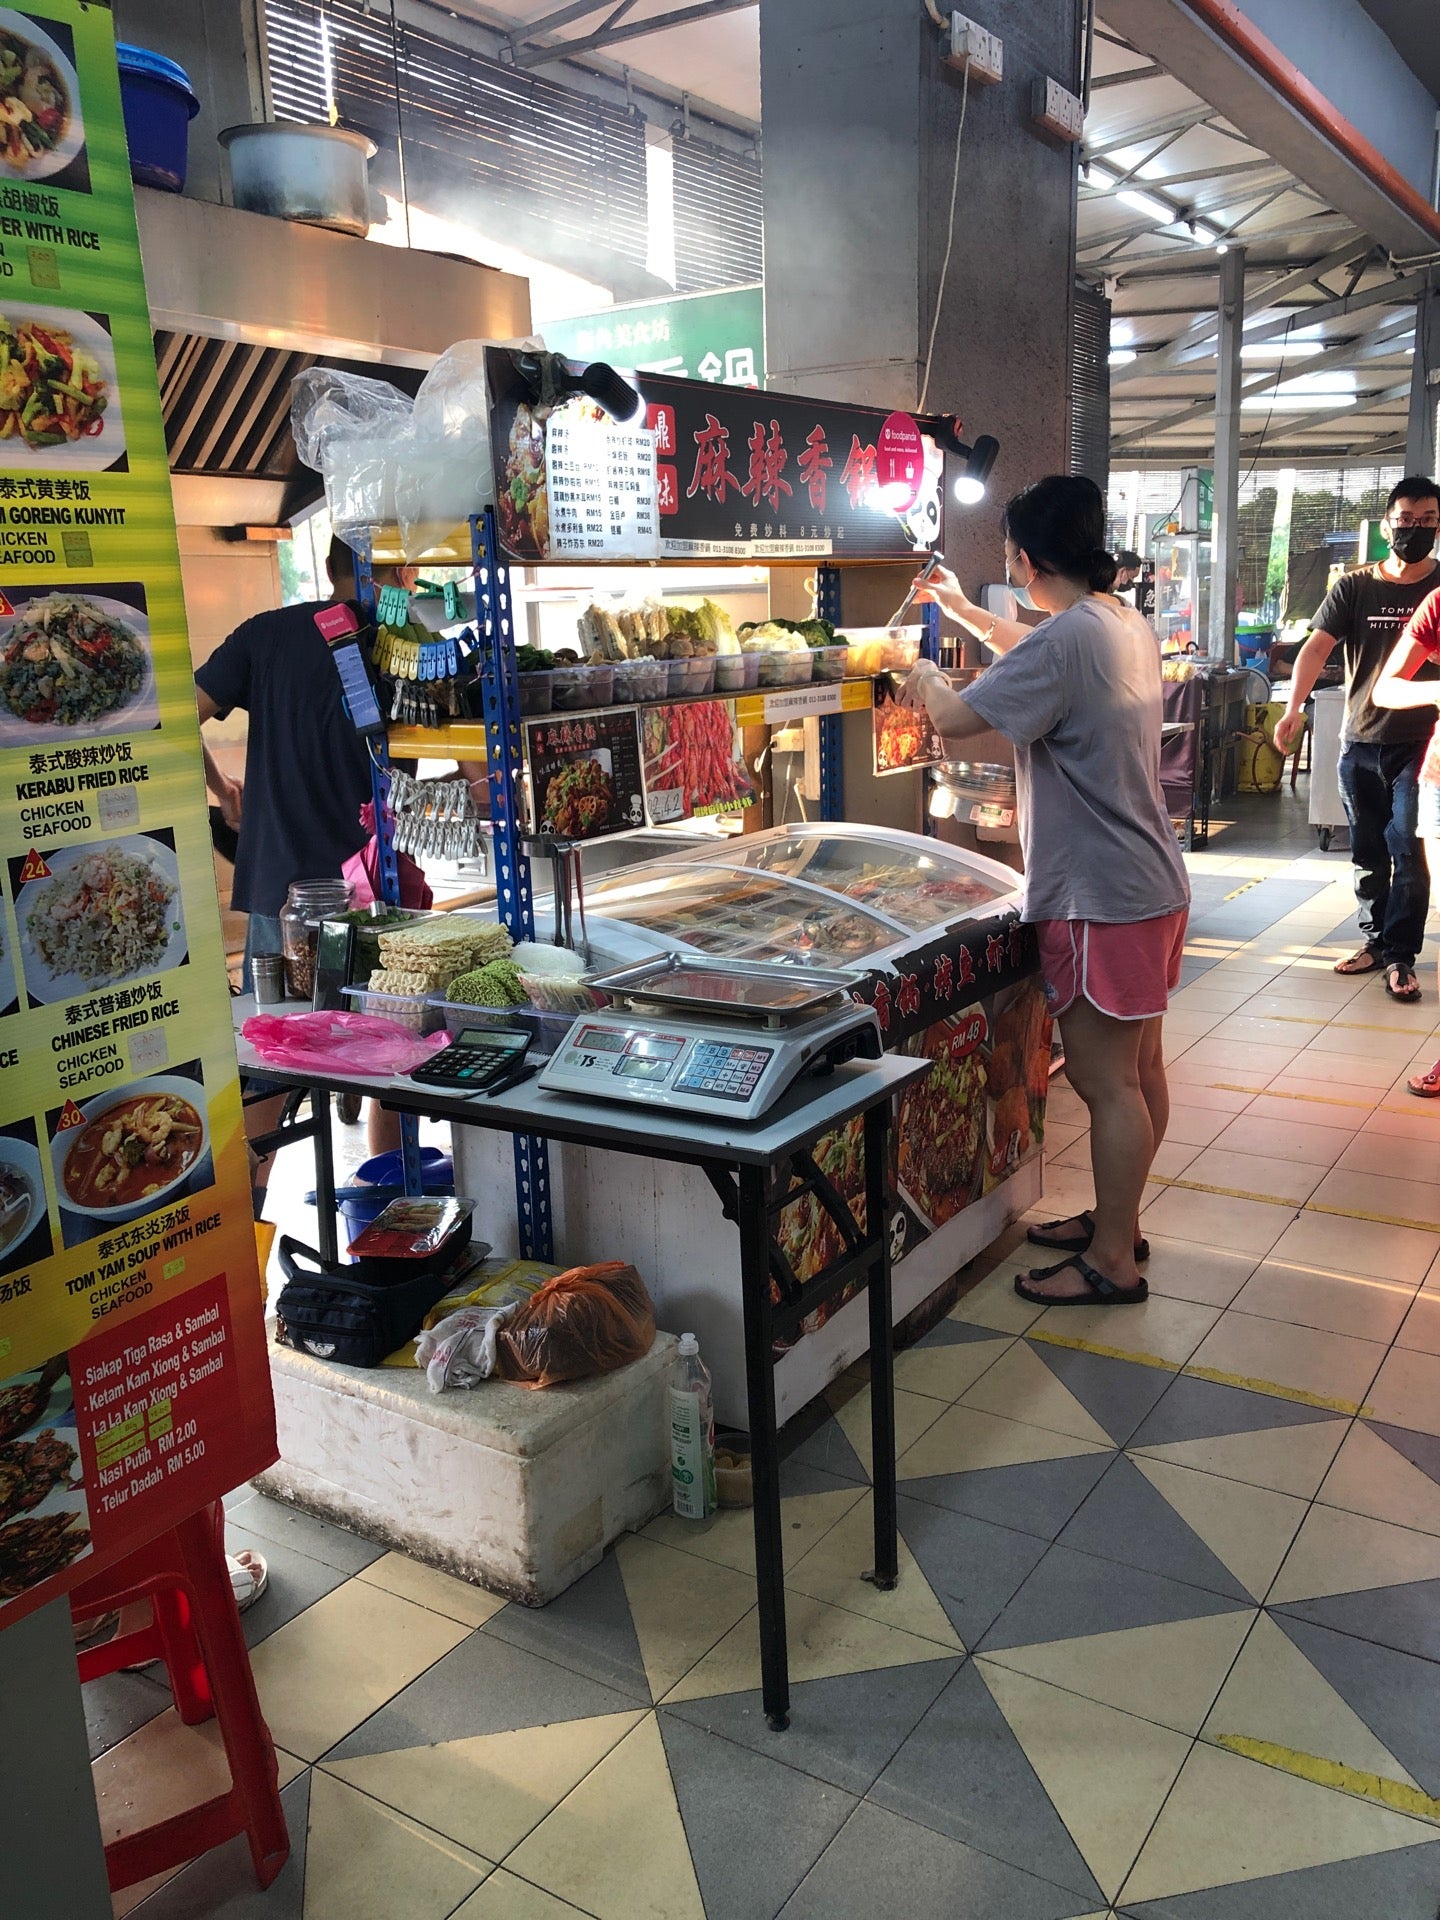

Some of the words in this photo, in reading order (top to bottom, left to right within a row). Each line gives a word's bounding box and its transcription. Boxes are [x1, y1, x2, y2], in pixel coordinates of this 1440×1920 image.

[0, 186, 60, 218] 胡椒饭
[25, 221, 64, 244] WITH
[66, 228, 101, 250] RICE
[892, 430, 916, 443] foodpanda
[10, 507, 71, 524] GORENG
[74, 508, 126, 524] KUNYIT
[586, 509, 601, 517] RM15
[587, 524, 602, 532] RM22
[588, 539, 603, 548] RM20
[638, 526, 652, 534] RM45
[29, 742, 133, 774] 泰式酸辣炒饭
[16, 776, 75, 800] KERABU
[78, 770, 116, 790] FRIED
[118, 765, 149, 784] RICE
[20, 800, 84, 822] CHICKEN
[23, 816, 92, 839] SEAFOOD
[26, 861, 45, 878] 24
[65, 980, 163, 1025] 泰式普通炒饭
[52, 1022, 110, 1052] CHINESE
[112, 1010, 148, 1034] FRIED
[152, 1000, 180, 1022] RICE
[952, 1034, 965, 1050] RM
[967, 1020, 980, 1042] 48
[57, 1044, 117, 1072] CHICKEN
[60, 1058, 124, 1089] SEAFOOD
[62, 1110, 80, 1128] 30
[98, 1205, 190, 1260] 泰式东炎汤饭
[64, 1276, 96, 1296] TOM
[97, 1260, 125, 1284] YAM
[128, 1242, 160, 1269] SOUP
[162, 1228, 193, 1251] WITH
[195, 1212, 222, 1238] RICE
[89, 1270, 146, 1304] CHICKEN
[91, 1283, 153, 1319] SEAFOOD
[86, 1357, 122, 1386] Siakap
[124, 1344, 147, 1366] Tiga
[148, 1331, 173, 1356] Rasa
[175, 1322, 183, 1338] &
[184, 1303, 220, 1334] Sambal
[89, 1383, 124, 1412] Ketam
[126, 1371, 150, 1393] Kam
[152, 1354, 180, 1380] Xiong
[182, 1346, 190, 1362] &
[191, 1326, 226, 1358] Sambal
[92, 1421, 107, 1438] La
[108, 1411, 122, 1429] La
[124, 1397, 148, 1420] Kam
[149, 1380, 178, 1404] Xiong
[179, 1374, 188, 1390] &
[189, 1353, 224, 1385] Sambal
[100, 1467, 123, 1488] Nasi
[125, 1447, 152, 1474] Putih
[158, 1433, 175, 1454] RM
[176, 1419, 197, 1440] 2.00
[101, 1490, 129, 1513] Telur
[131, 1467, 163, 1496] Dadah
[167, 1453, 184, 1475] RM
[185, 1440, 205, 1462] 5.00
